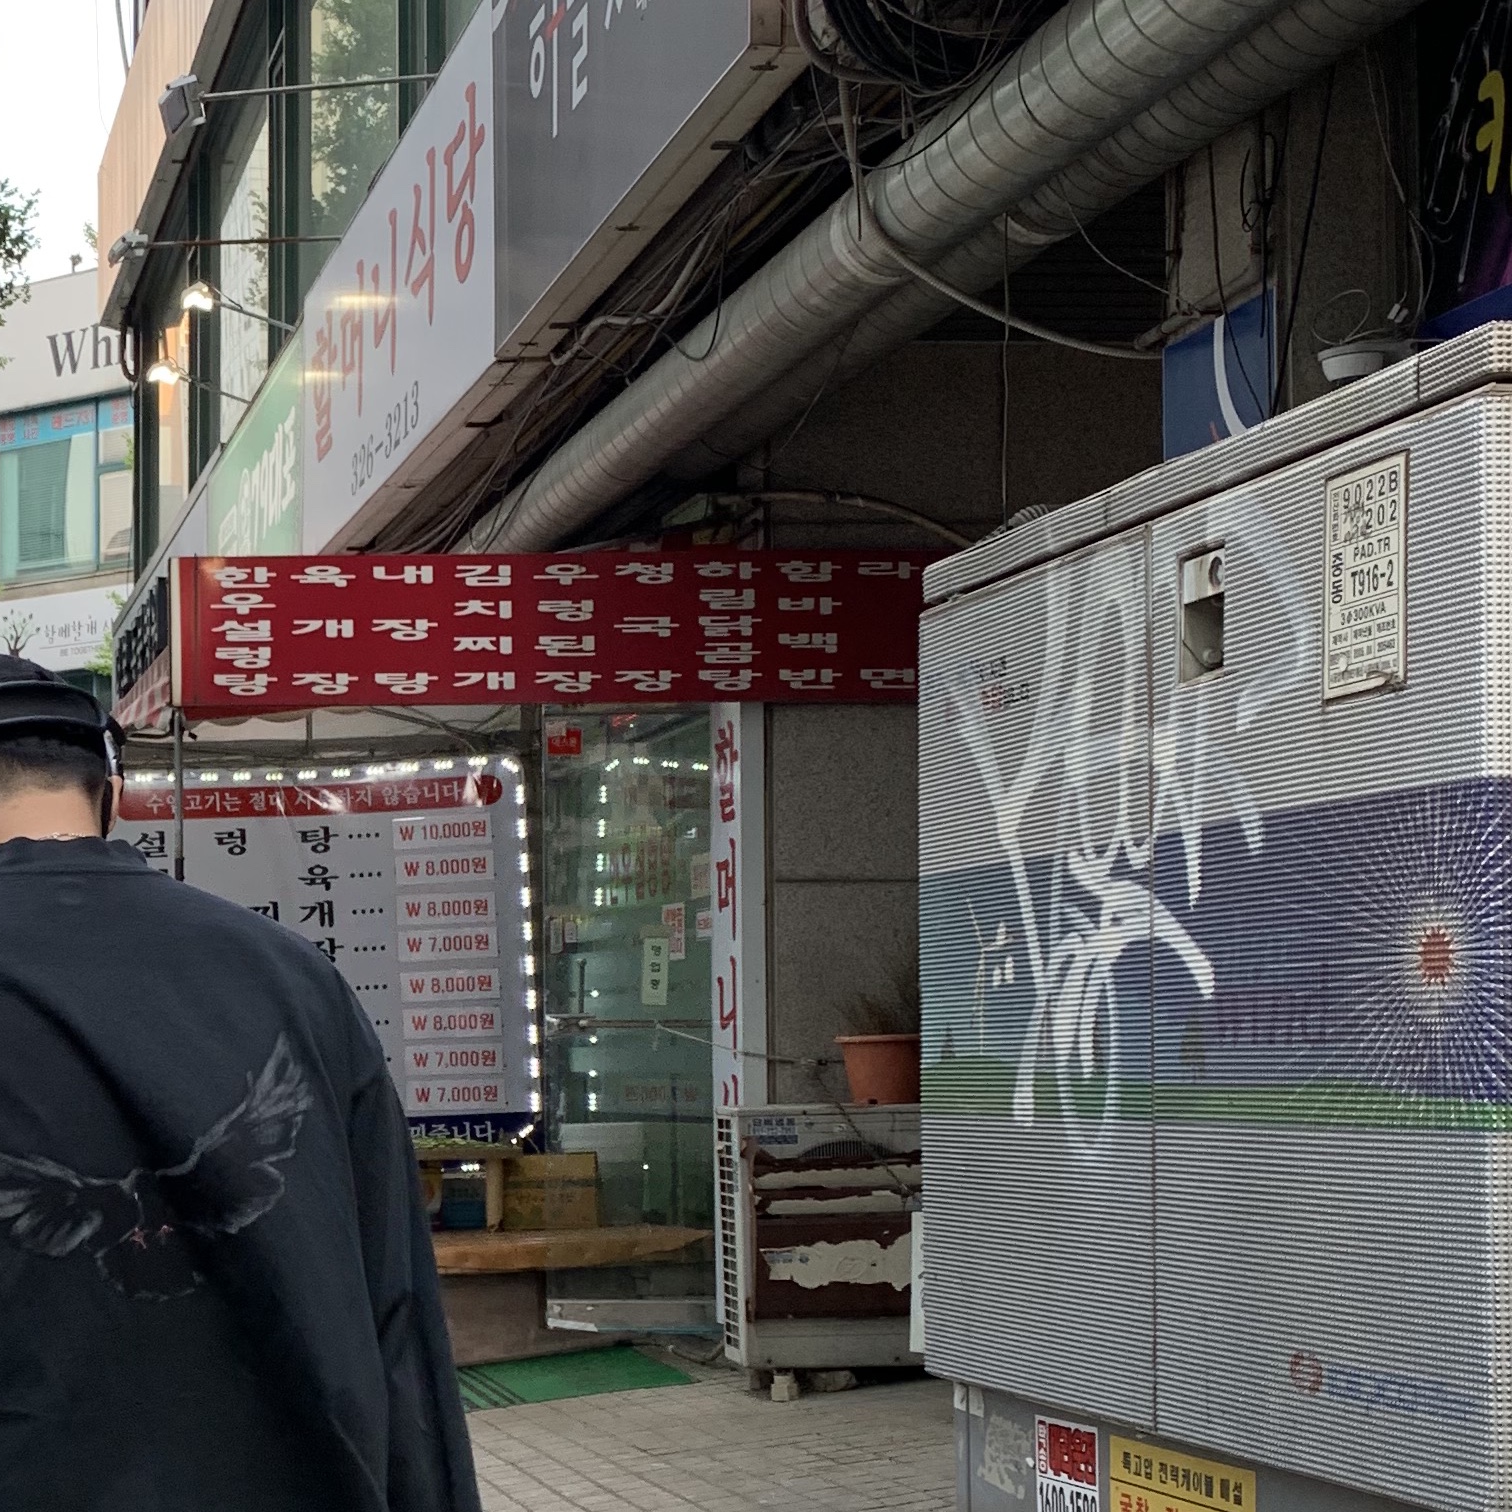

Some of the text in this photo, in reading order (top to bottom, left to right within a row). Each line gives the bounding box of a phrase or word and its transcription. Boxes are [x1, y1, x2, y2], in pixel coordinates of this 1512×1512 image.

[310, 81, 486, 463] 할머니식당
[350, 379, 420, 497] 326-3213
[1342, 470, 1399, 509] 9022B
[1350, 559, 1394, 598] T916-2
[1352, 536, 1391, 563] PAD.TR
[290, 564, 359, 696] 육개장
[370, 564, 439, 696] 내장탕
[452, 563, 516, 691] 김치찌개
[614, 562, 682, 692] 청국장
